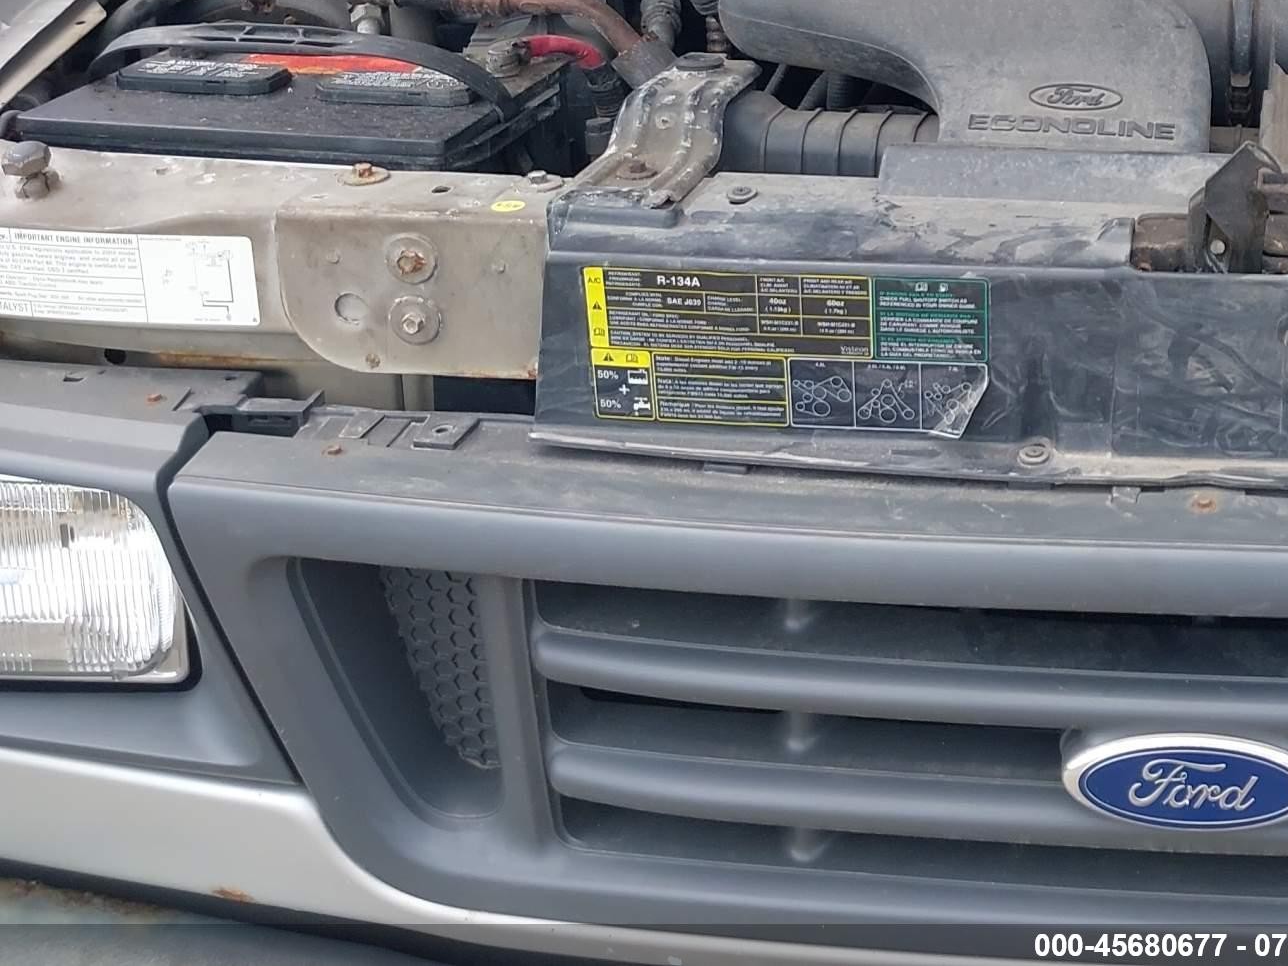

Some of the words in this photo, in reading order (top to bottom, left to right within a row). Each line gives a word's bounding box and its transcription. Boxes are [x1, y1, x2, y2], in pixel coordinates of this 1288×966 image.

[1047, 87, 1104, 106] Ford
[968, 114, 1176, 140] ECONOLINE
[83, 236, 133, 245] INFORMATION
[657, 275, 701, 287] R-134A
[667, 297, 682, 305] SAE
[769, 297, 787, 305] 40oz
[826, 299, 845, 307] 60oz
[597, 370, 619, 381] 50%
[600, 399, 622, 409] 50%
[1128, 758, 1258, 811] Ford
